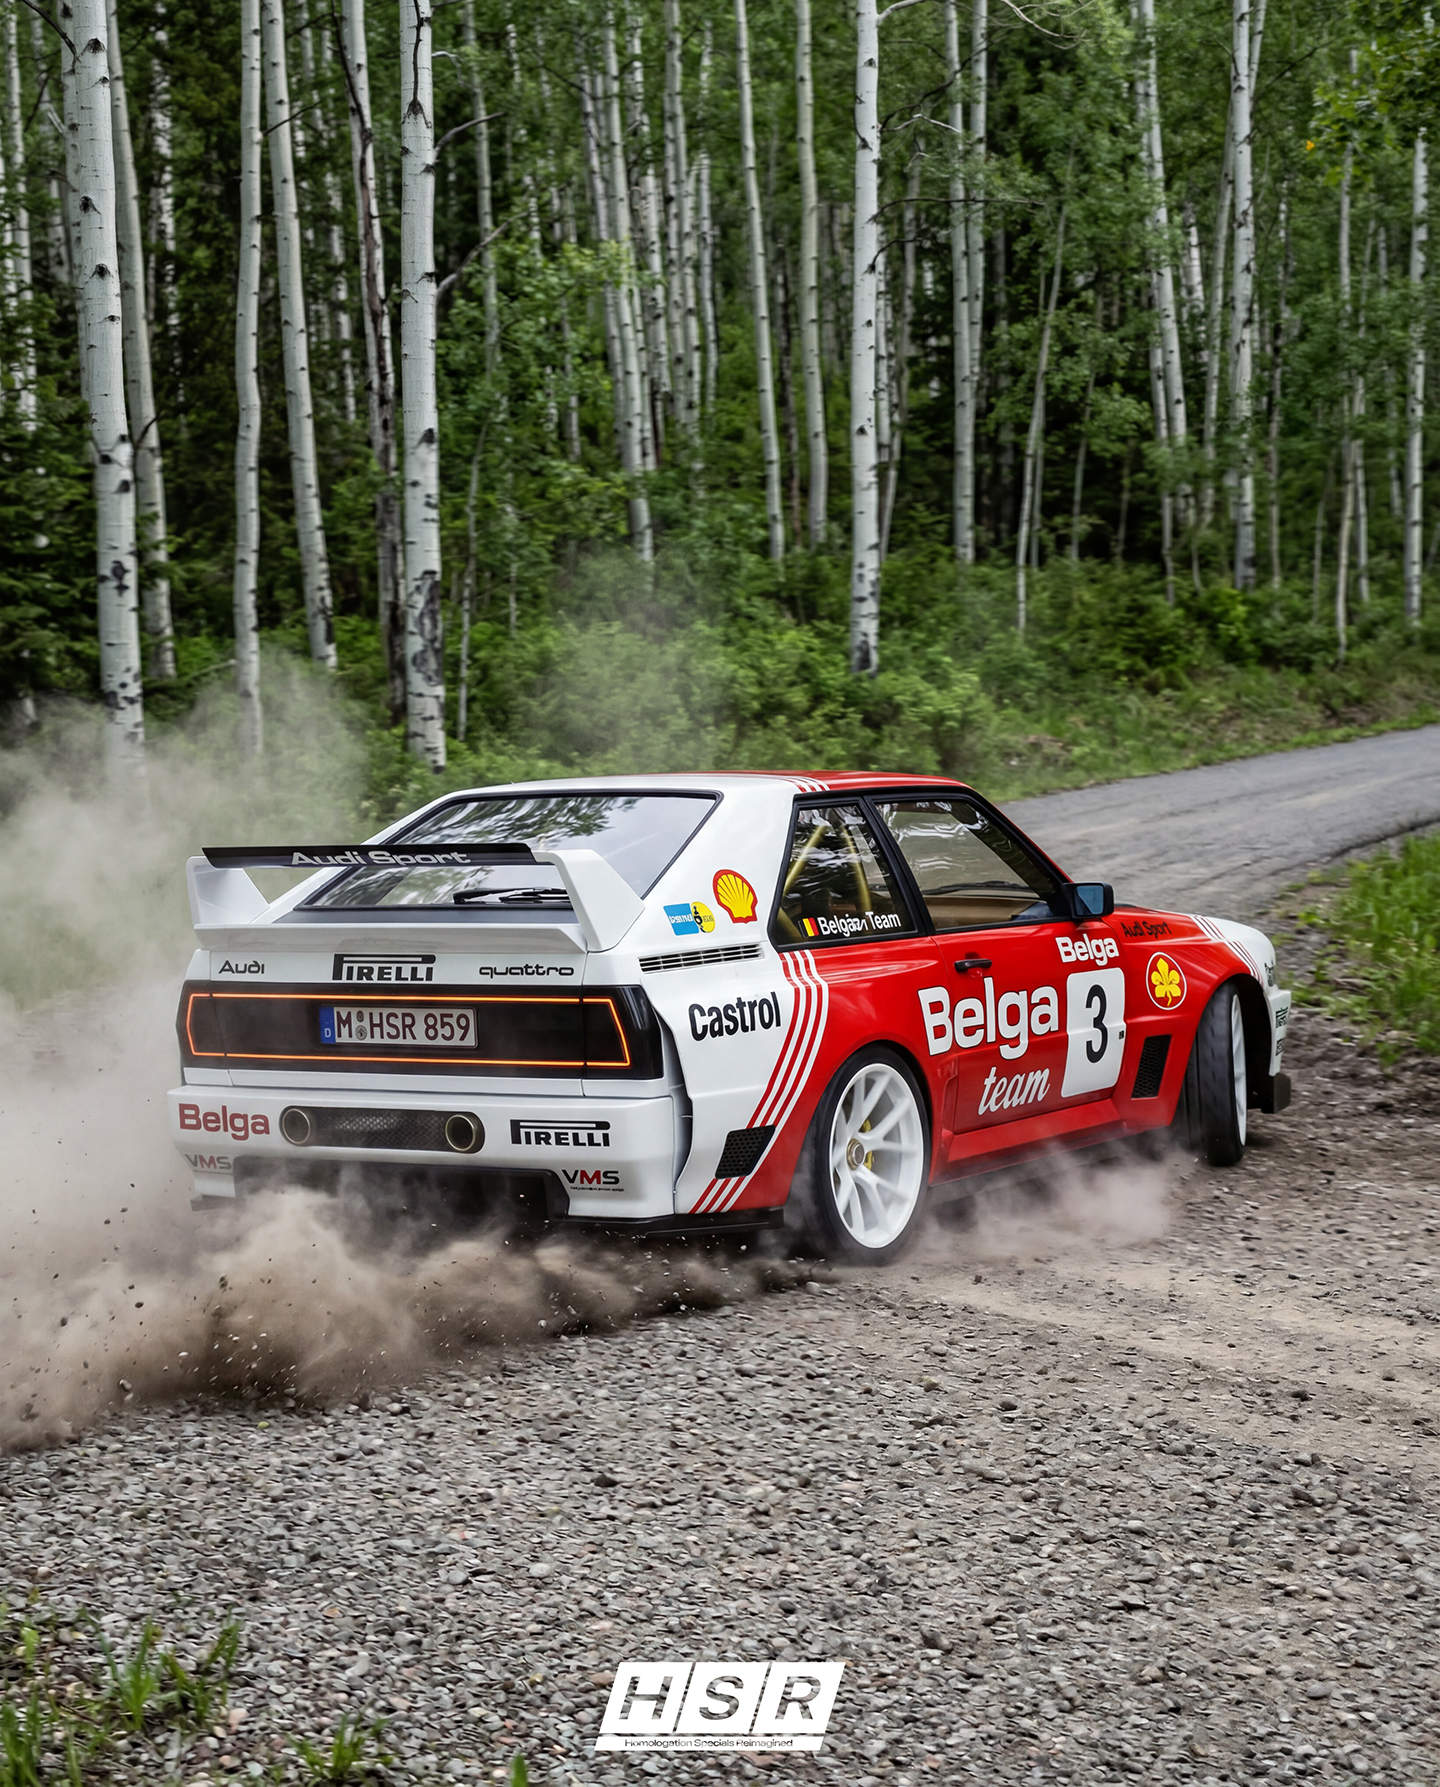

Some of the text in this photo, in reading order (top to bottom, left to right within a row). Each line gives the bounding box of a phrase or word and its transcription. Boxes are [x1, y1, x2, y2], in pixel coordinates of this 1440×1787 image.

[292, 850, 472, 866] Audi Sport
[865, 911, 902, 931] Team
[1120, 920, 1173, 938] Audi Sport
[1055, 933, 1120, 967] Belga
[218, 959, 265, 975] Audi
[331, 953, 436, 982] PIRELLI
[479, 964, 575, 980] quattro
[336, 1010, 471, 1042] M HSR 859
[688, 991, 781, 1042] Castrol
[917, 976, 1060, 1060] Belga
[1085, 983, 1108, 1064] 3
[324, 1027, 332, 1038] D
[977, 1066, 1051, 1116] team
[178, 1103, 270, 1141] Belga
[510, 1119, 611, 1147] PIRELLI
[184, 1153, 232, 1170] VMS
[561, 1169, 620, 1185] VMS
